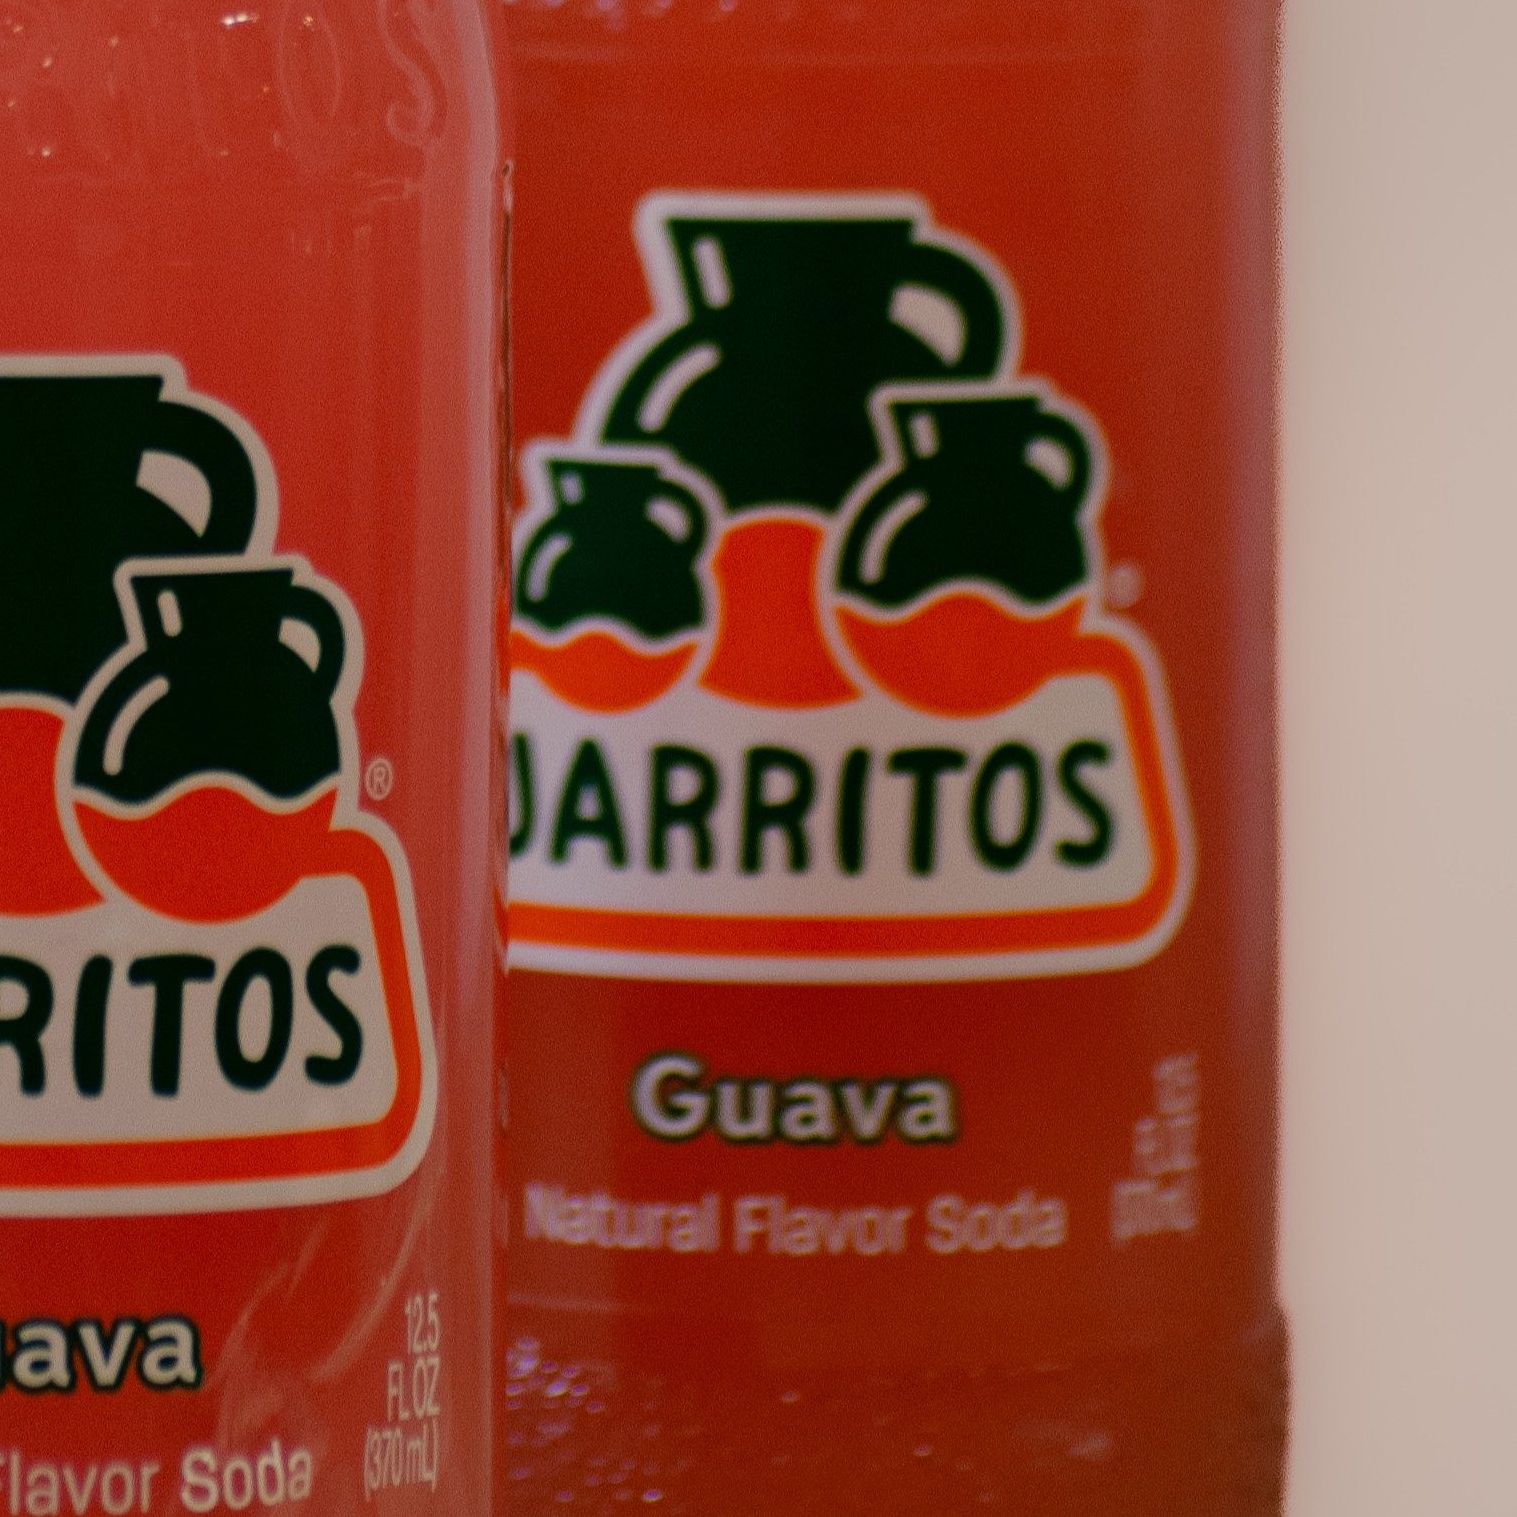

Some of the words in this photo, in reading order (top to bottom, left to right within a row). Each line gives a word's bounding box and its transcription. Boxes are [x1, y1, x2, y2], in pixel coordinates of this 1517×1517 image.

[628, 1050, 960, 1144] Guava
[524, 1183, 720, 1253] Natural
[733, 1194, 914, 1256] Flavor
[925, 1189, 1069, 1255] Soda
[386, 1359, 410, 1421] FL
[413, 1353, 440, 1420] OZ
[179, 1436, 316, 1513] Soda
[363, 1427, 403, 1502] (370
